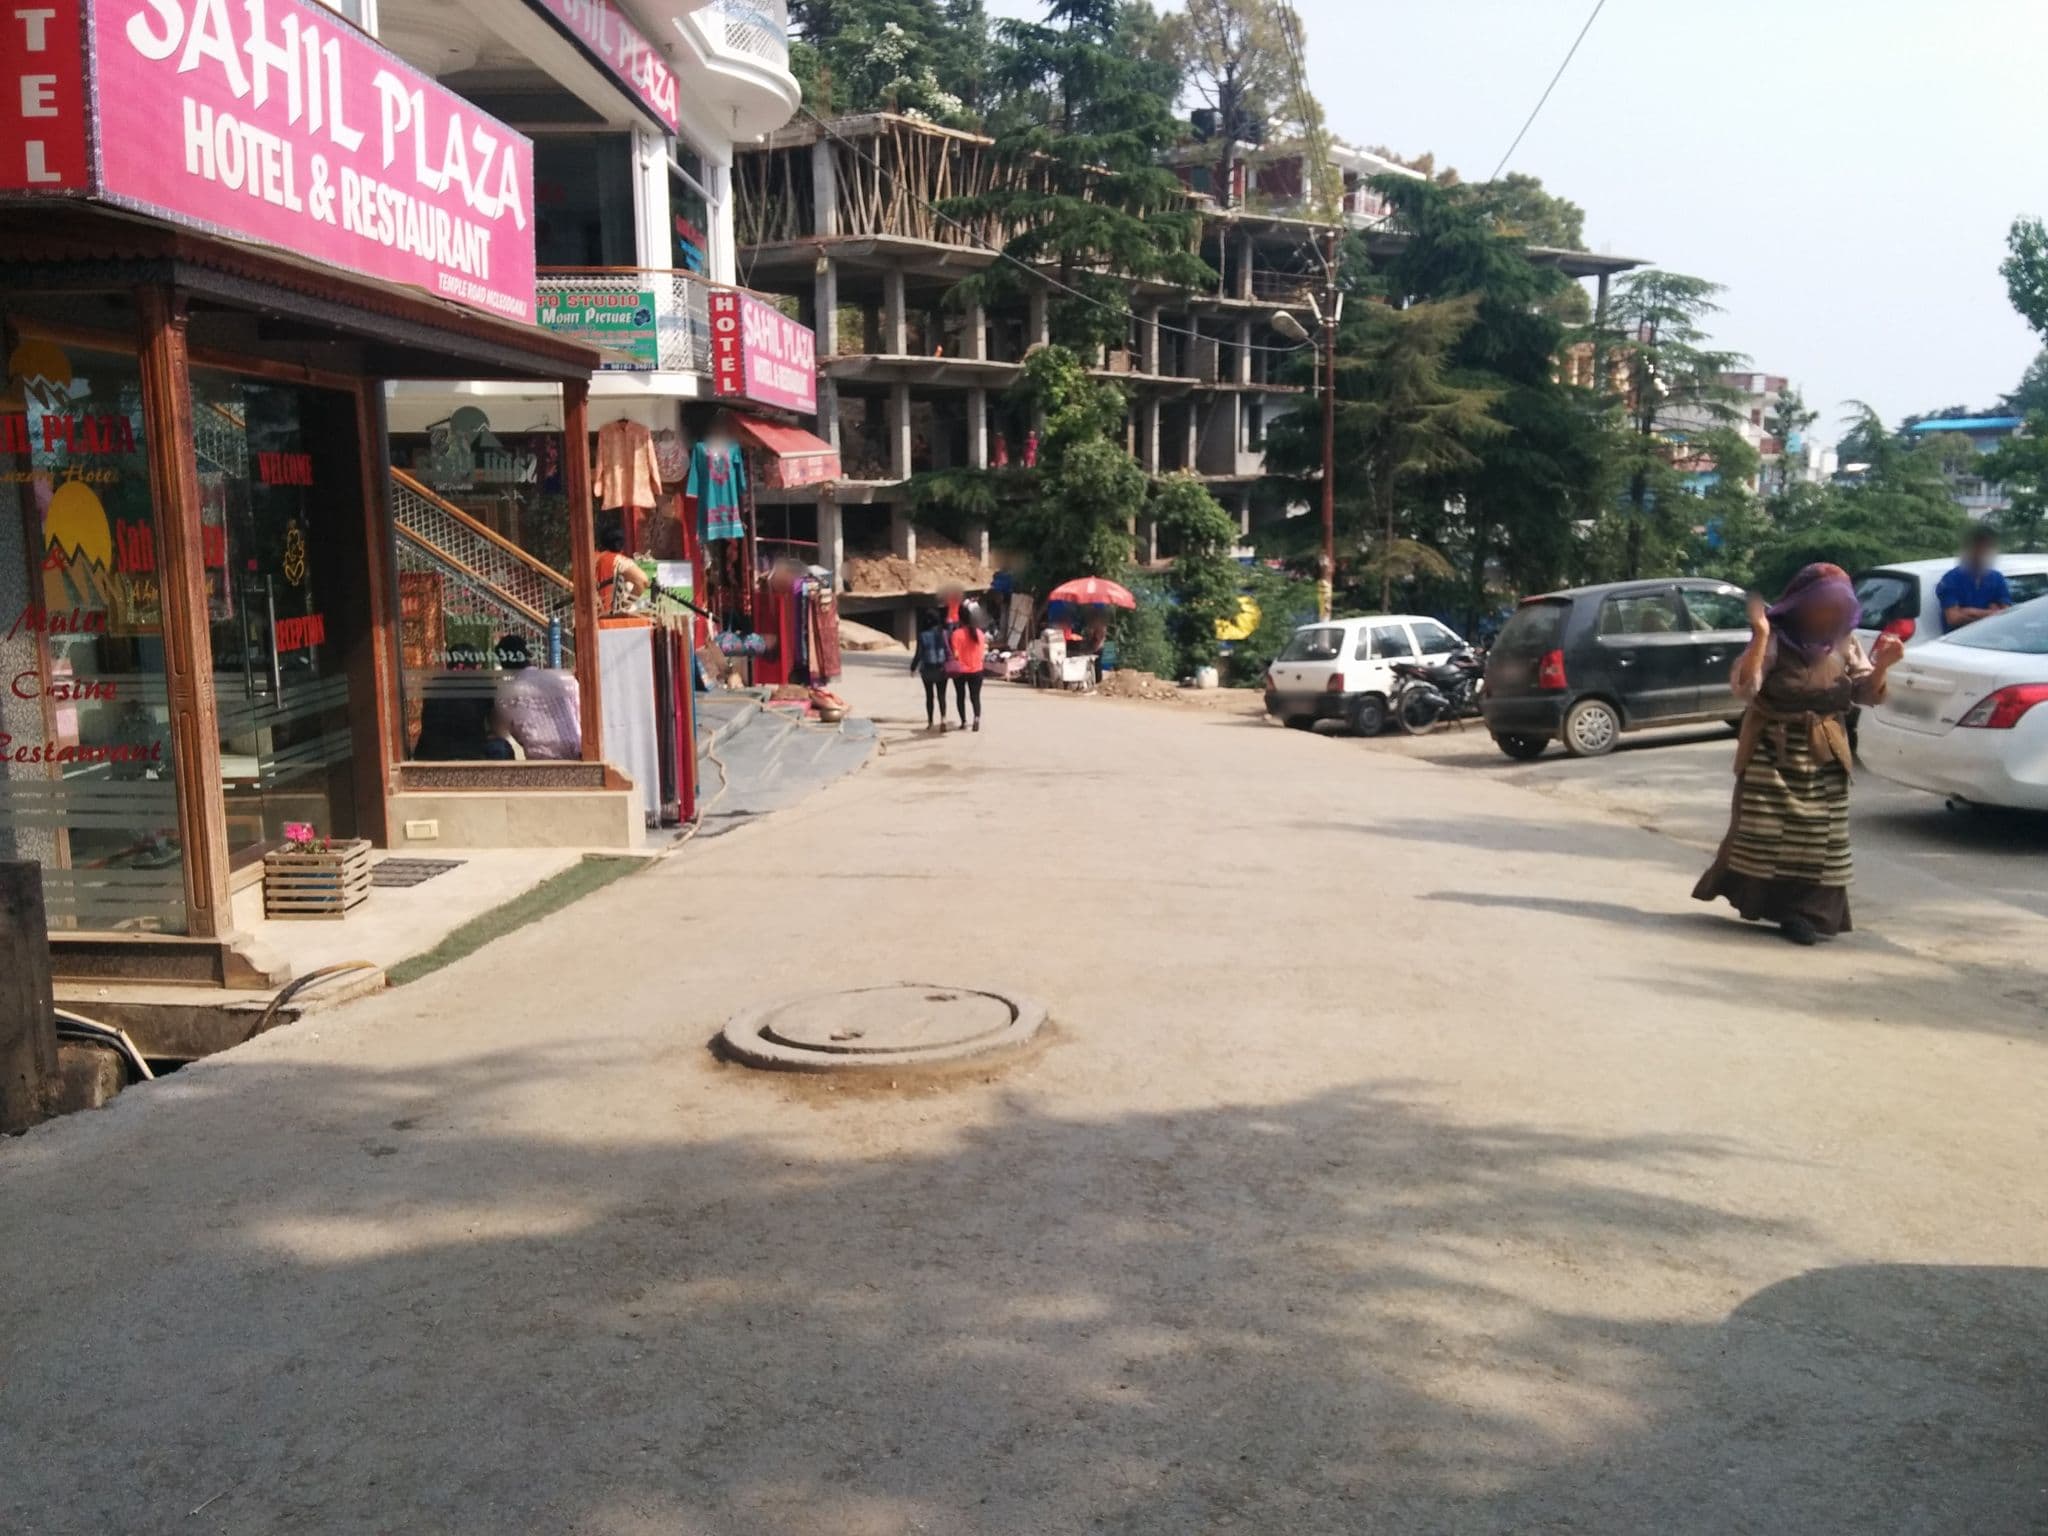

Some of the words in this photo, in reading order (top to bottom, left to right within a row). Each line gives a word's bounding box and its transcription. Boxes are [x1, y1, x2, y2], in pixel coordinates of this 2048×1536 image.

[617, 20, 677, 122] PLAZA
[126, 0, 365, 153] SAHIL
[372, 69, 526, 232] PLAZA
[183, 96, 302, 213] HOTEL
[309, 153, 337, 225] &
[341, 166, 491, 280] RESTAURANT
[567, 294, 640, 308] STUDIO
[743, 301, 783, 360] SAHIL
[715, 297, 737, 392] HOTEL
[42, 414, 137, 453] PLAZA
[258, 451, 313, 485] WELCOME
